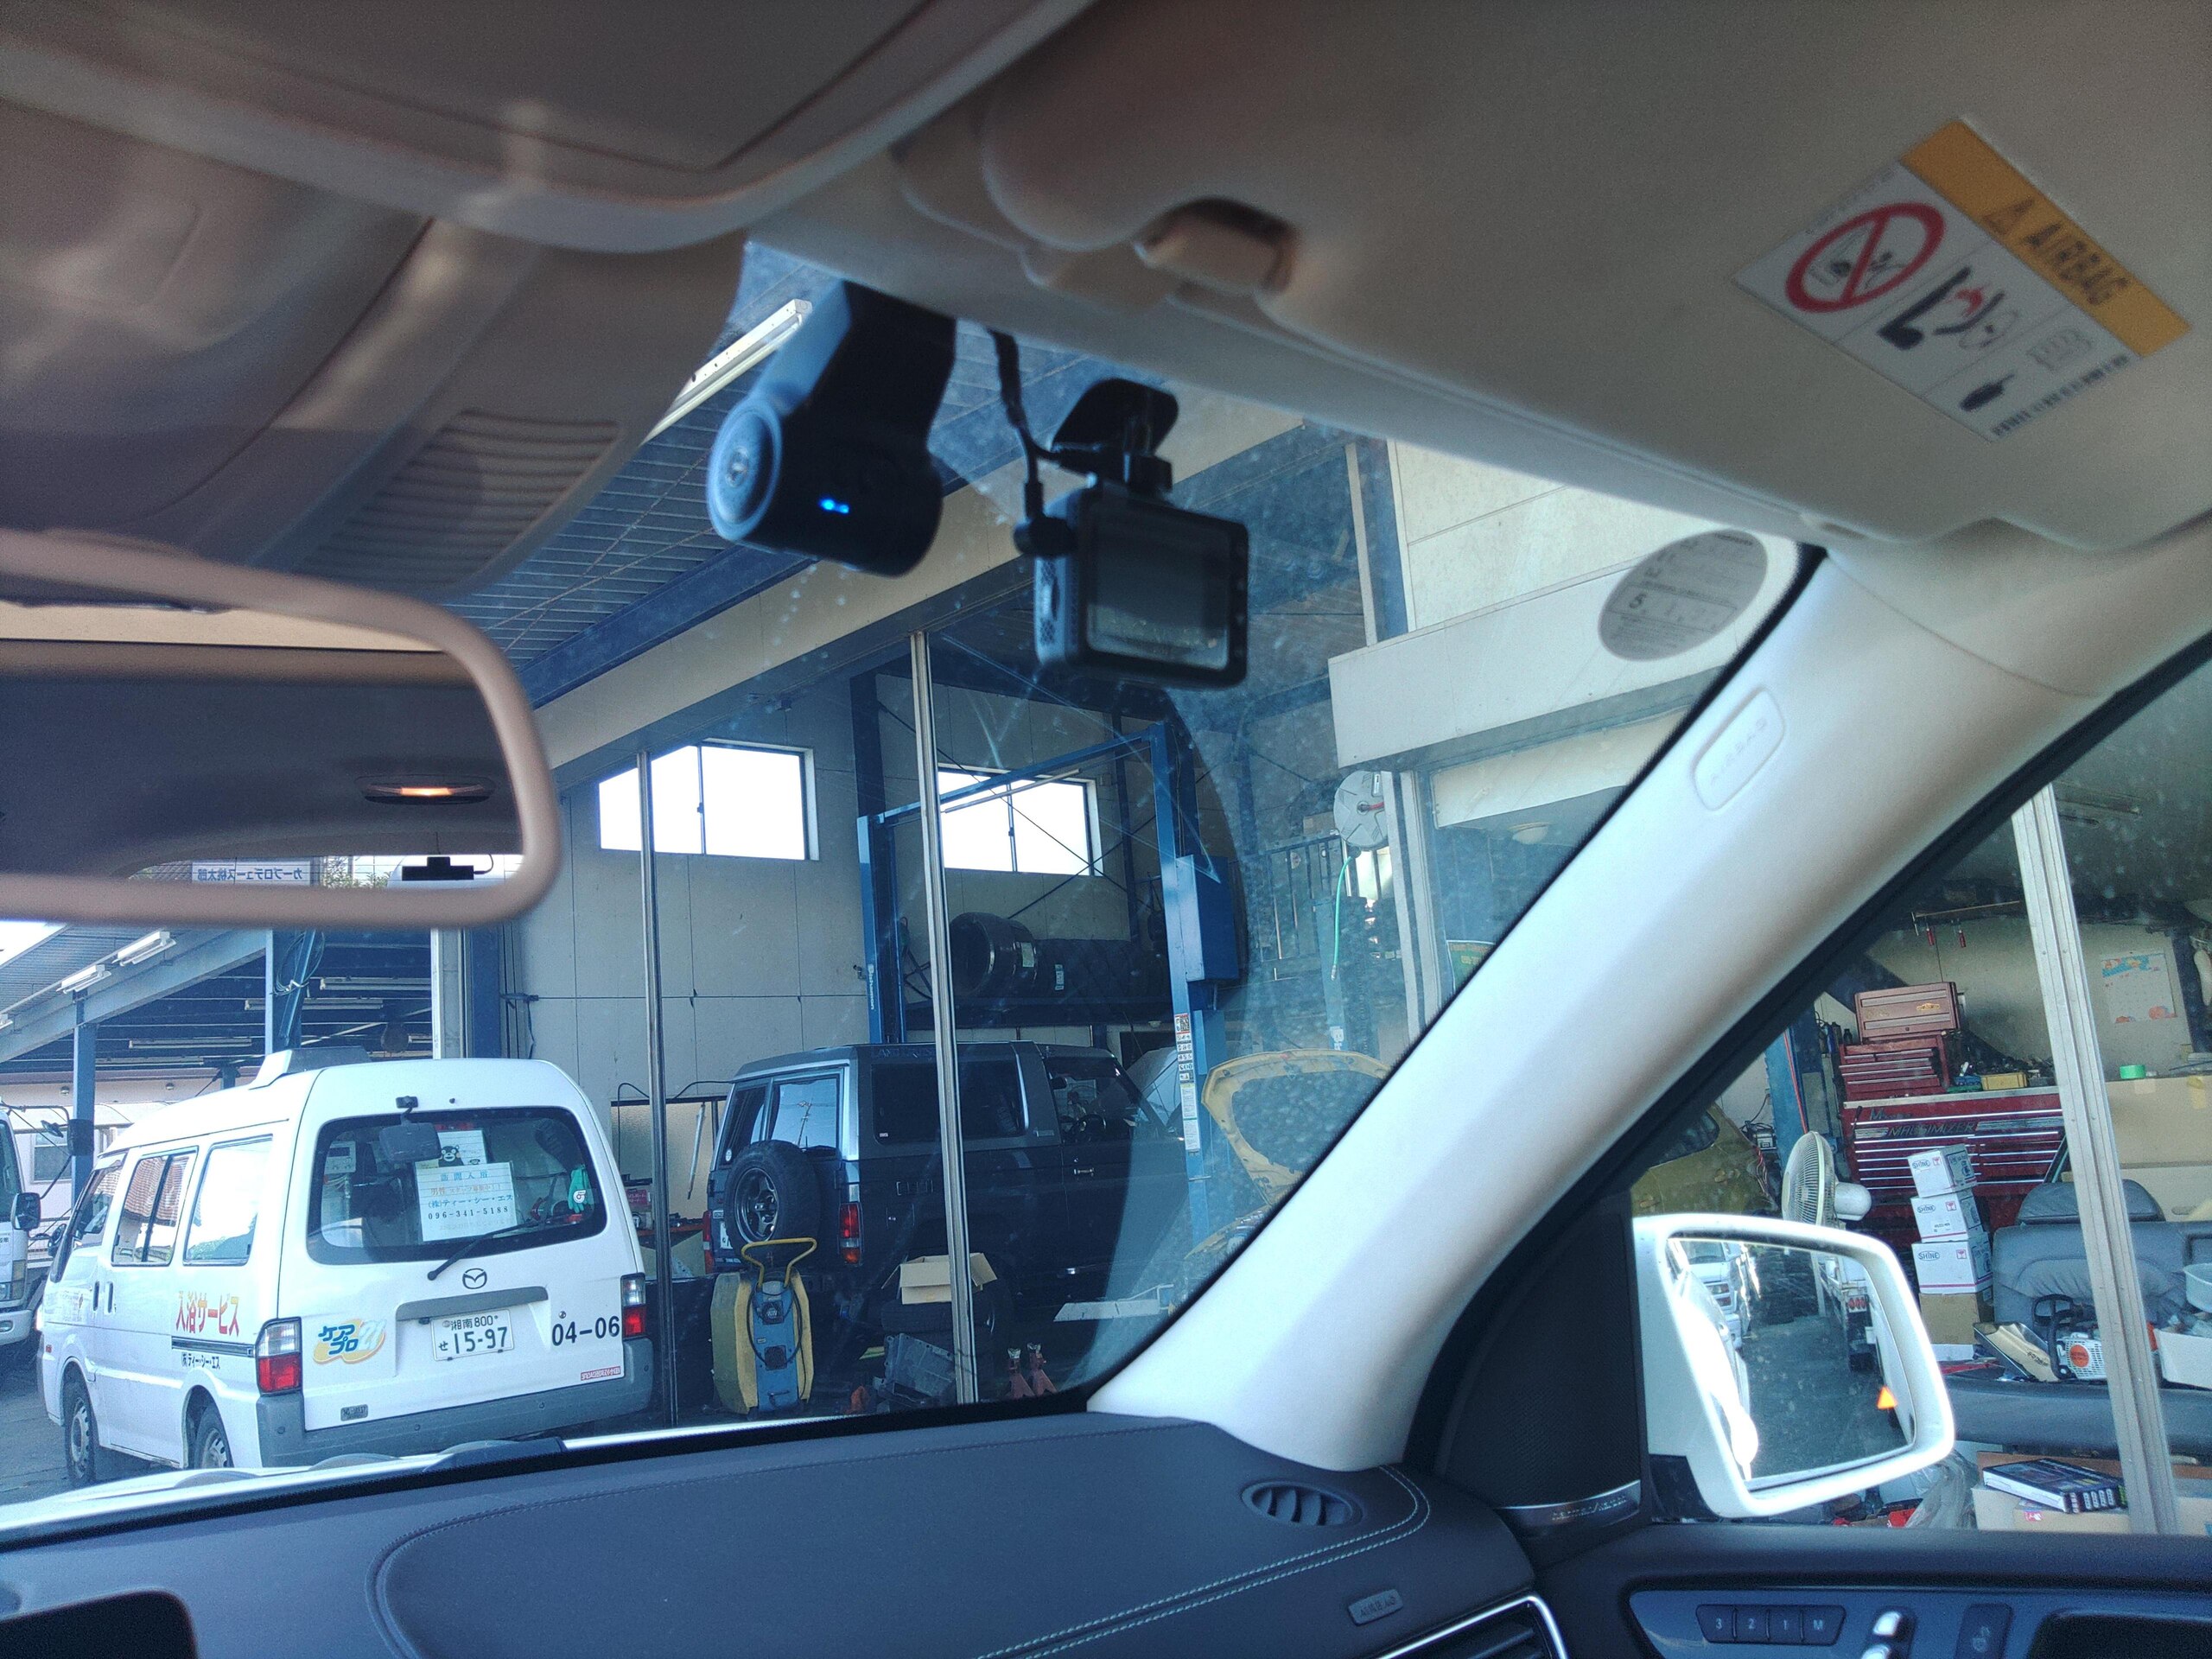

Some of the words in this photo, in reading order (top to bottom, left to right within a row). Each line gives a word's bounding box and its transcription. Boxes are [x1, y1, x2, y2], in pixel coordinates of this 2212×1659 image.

[2021, 223, 2129, 305] AIRBAG
[175, 1290, 239, 1337] 入浴サービス
[474, 1315, 493, 1327] 800
[454, 1326, 508, 1354] 15-97
[551, 1316, 620, 1346] 04-06
[1715, 1618, 1722, 1630] 3
[1748, 1618, 1756, 1630] 2
[1783, 1619, 1789, 1630] 1
[1813, 1619, 1825, 1630] M
